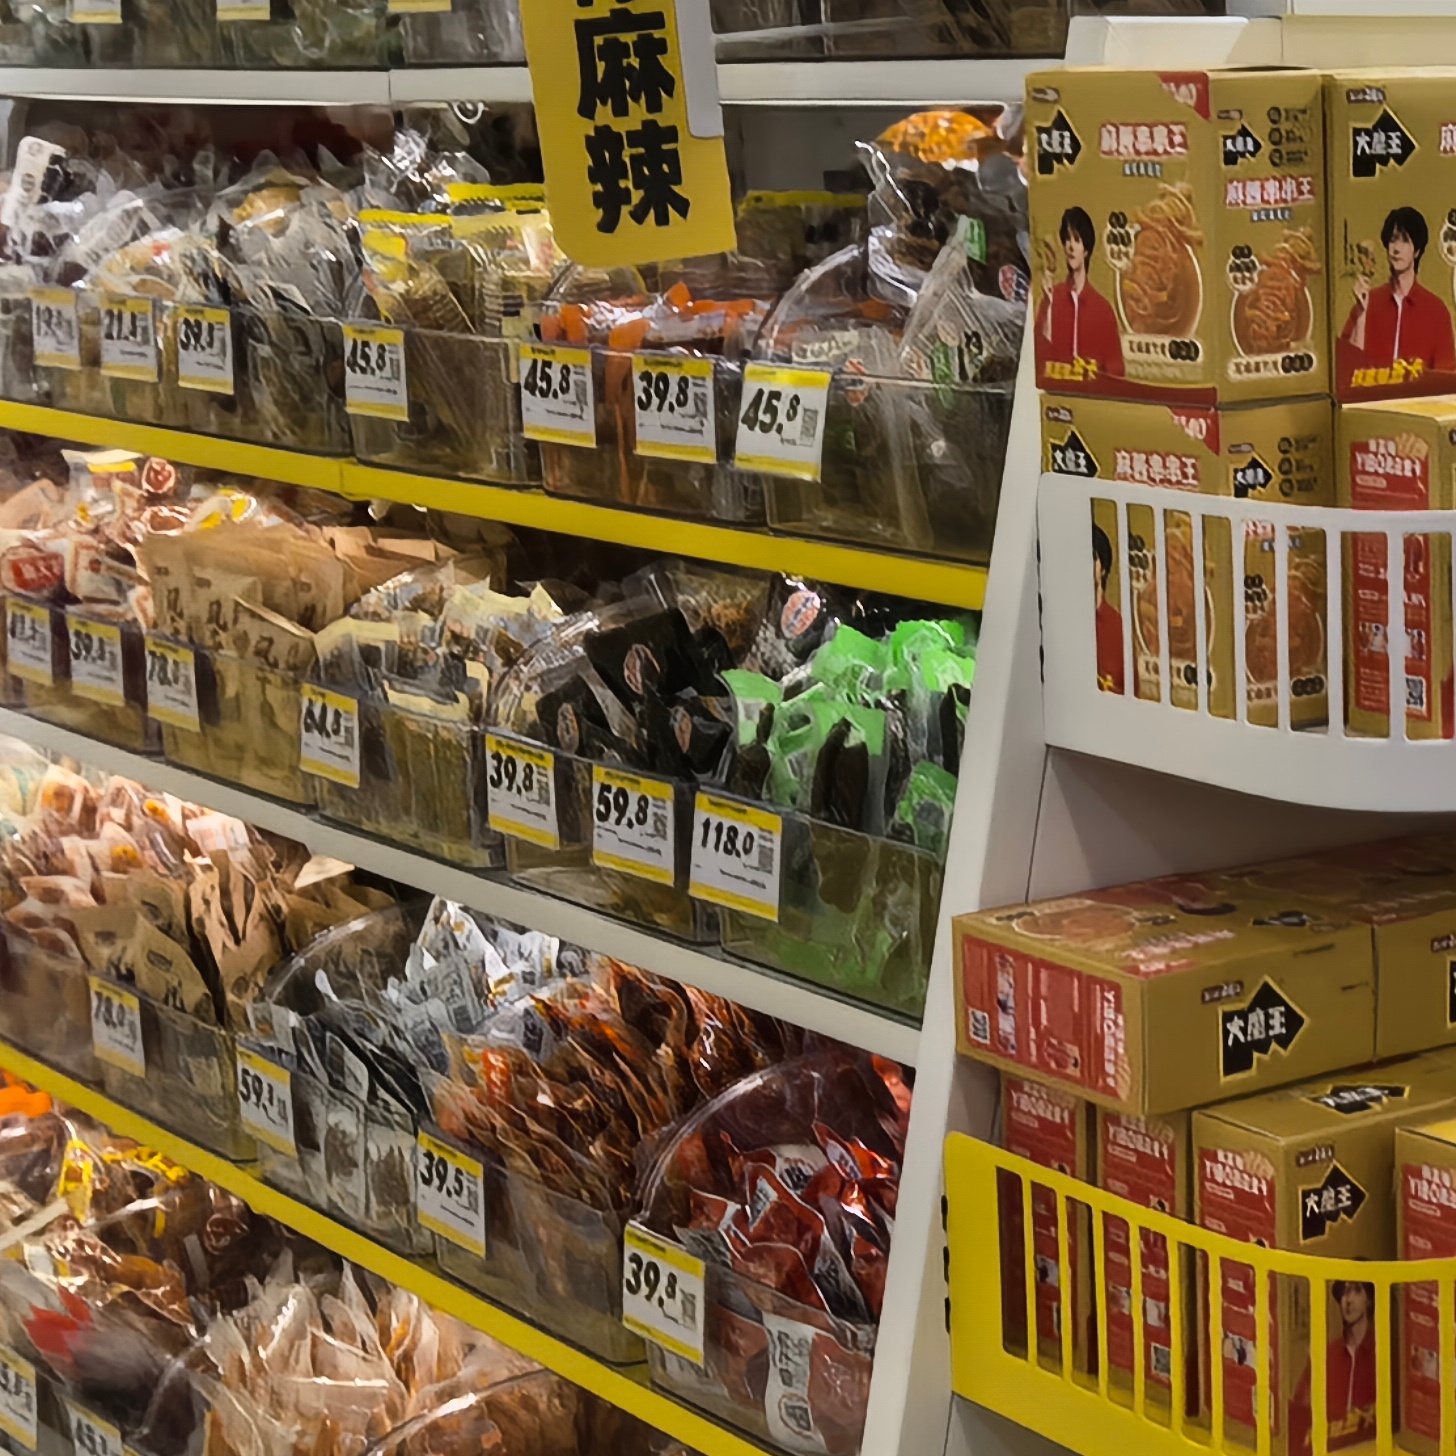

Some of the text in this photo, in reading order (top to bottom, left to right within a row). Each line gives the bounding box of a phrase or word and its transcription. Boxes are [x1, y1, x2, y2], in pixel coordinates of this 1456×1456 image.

[524, 359, 571, 399] 45.8
[637, 371, 689, 413] 39.8
[742, 389, 800, 435] 45.8
[489, 752, 535, 794] 39.8
[596, 790, 650, 831] 59.8
[701, 818, 755, 858] 118.0
[625, 1253, 679, 1307] 39.8
